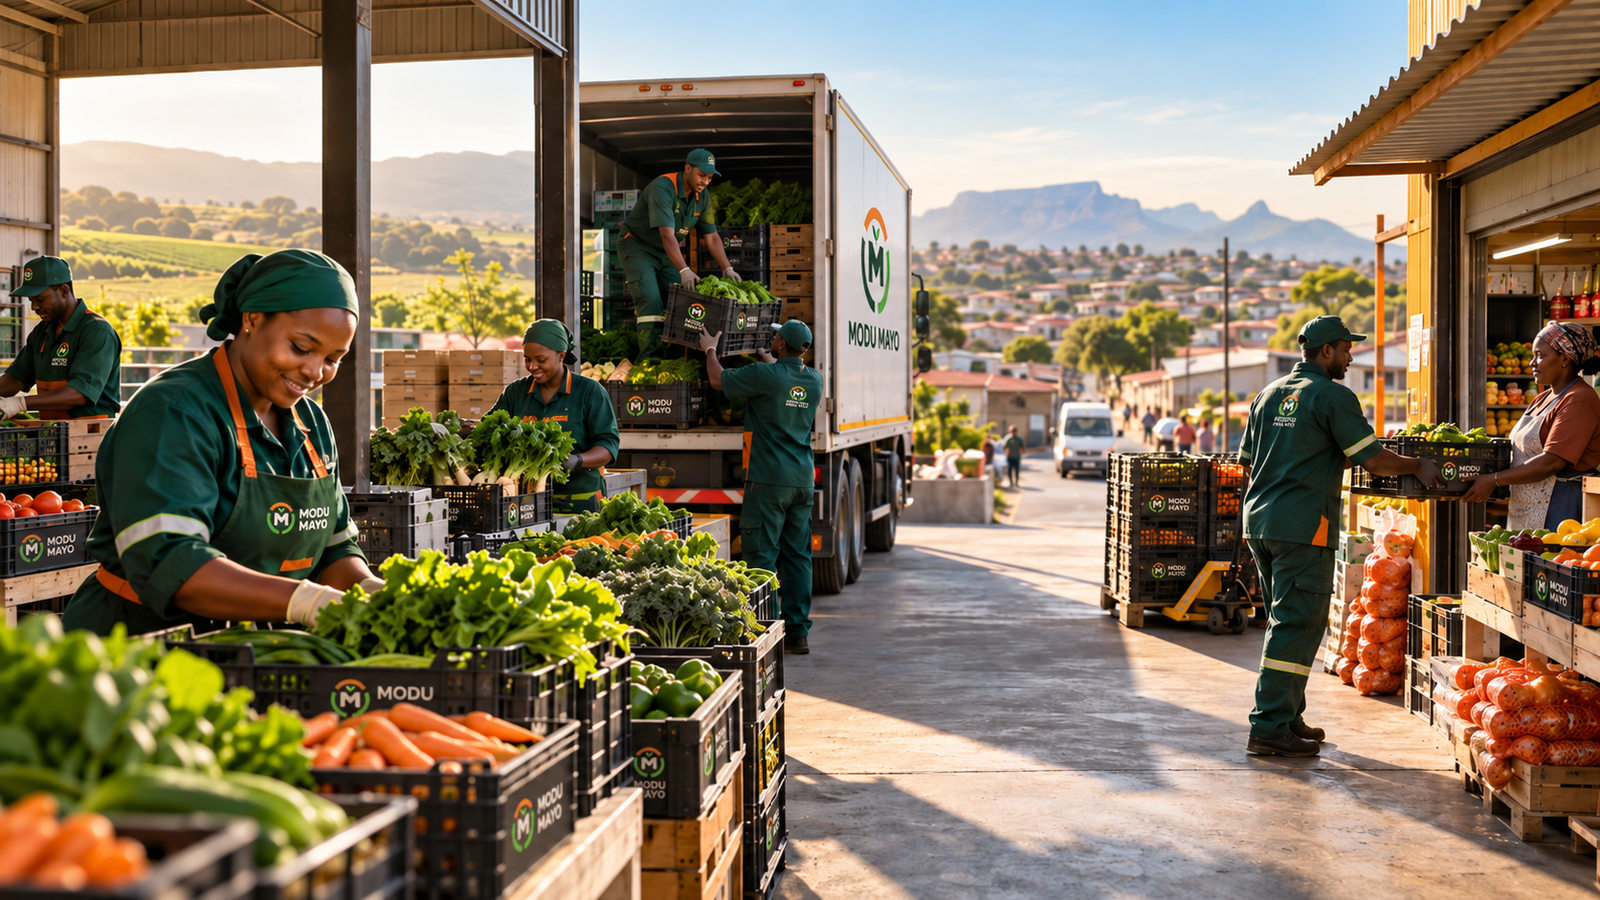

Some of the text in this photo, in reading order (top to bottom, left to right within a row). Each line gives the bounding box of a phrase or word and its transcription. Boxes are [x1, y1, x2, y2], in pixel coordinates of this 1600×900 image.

[868, 240, 884, 287] M
[848, 320, 900, 352] MODU MAYO
[630, 402, 641, 411] M
[647, 399, 672, 407] MODU
[647, 406, 672, 414] MAYO
[274, 512, 289, 526] M
[299, 507, 330, 519] MODU
[299, 519, 328, 531] MAYO
[47, 534, 76, 546] MODU
[25, 544, 38, 556] M
[47, 545, 75, 557] MAYO
[1549, 581, 1569, 596] MODU
[1549, 593, 1568, 607] MAYO
[340, 691, 361, 708] M
[377, 686, 434, 701] MODU
[640, 757, 657, 770] M
[633, 780, 666, 790] MODU
[537, 782, 563, 813] MODU
[537, 804, 562, 834] MAYO
[517, 812, 530, 840] M
